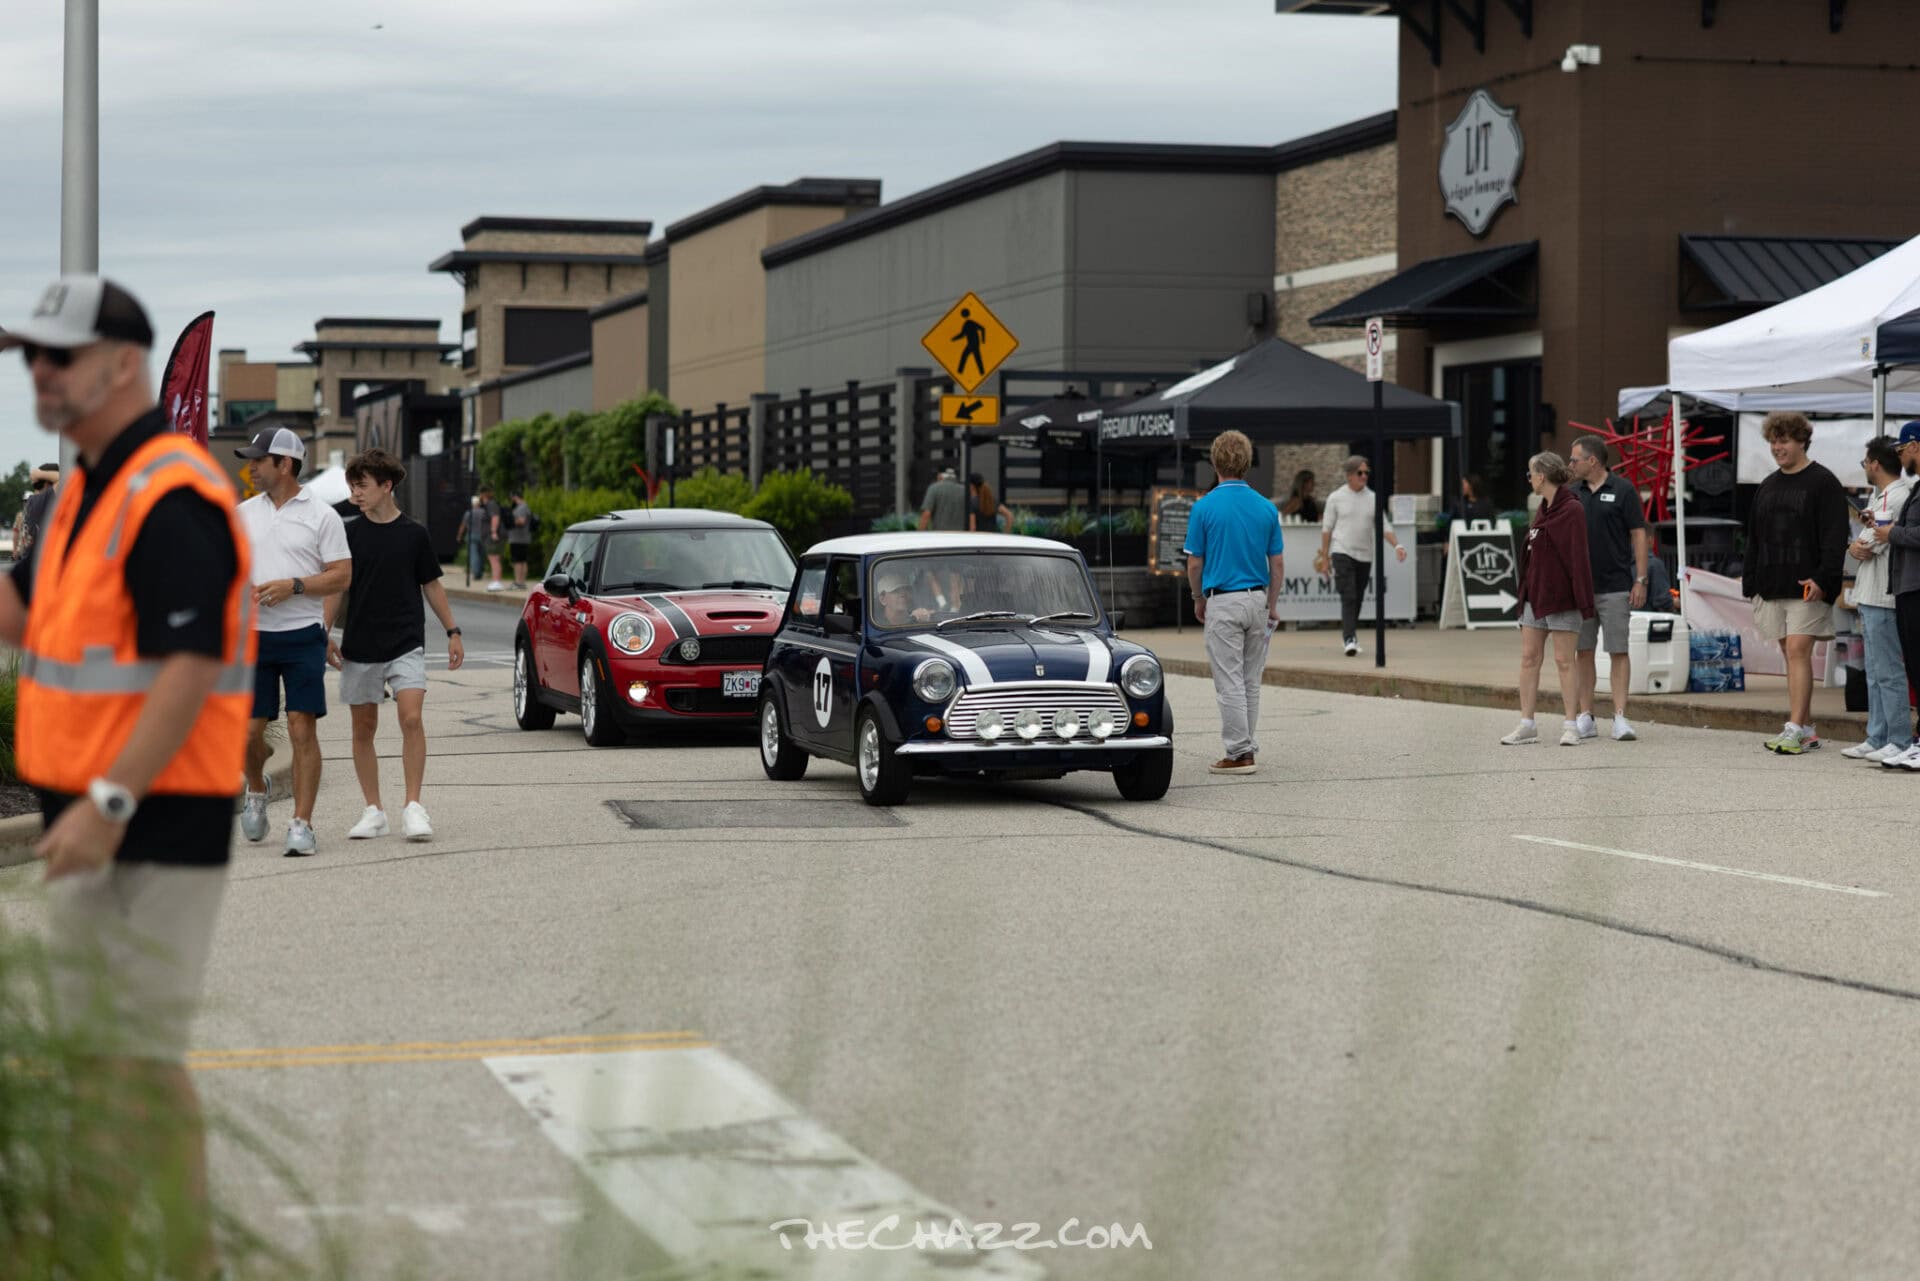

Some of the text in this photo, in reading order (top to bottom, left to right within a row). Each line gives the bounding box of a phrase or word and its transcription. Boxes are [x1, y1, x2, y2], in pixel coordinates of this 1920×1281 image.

[1465, 121, 1492, 175] LIT
[1102, 415, 1139, 440] PREMIUM
[1139, 413, 1170, 437] CIGARS
[1476, 552, 1498, 569] LIT
[815, 671, 831, 713] 17
